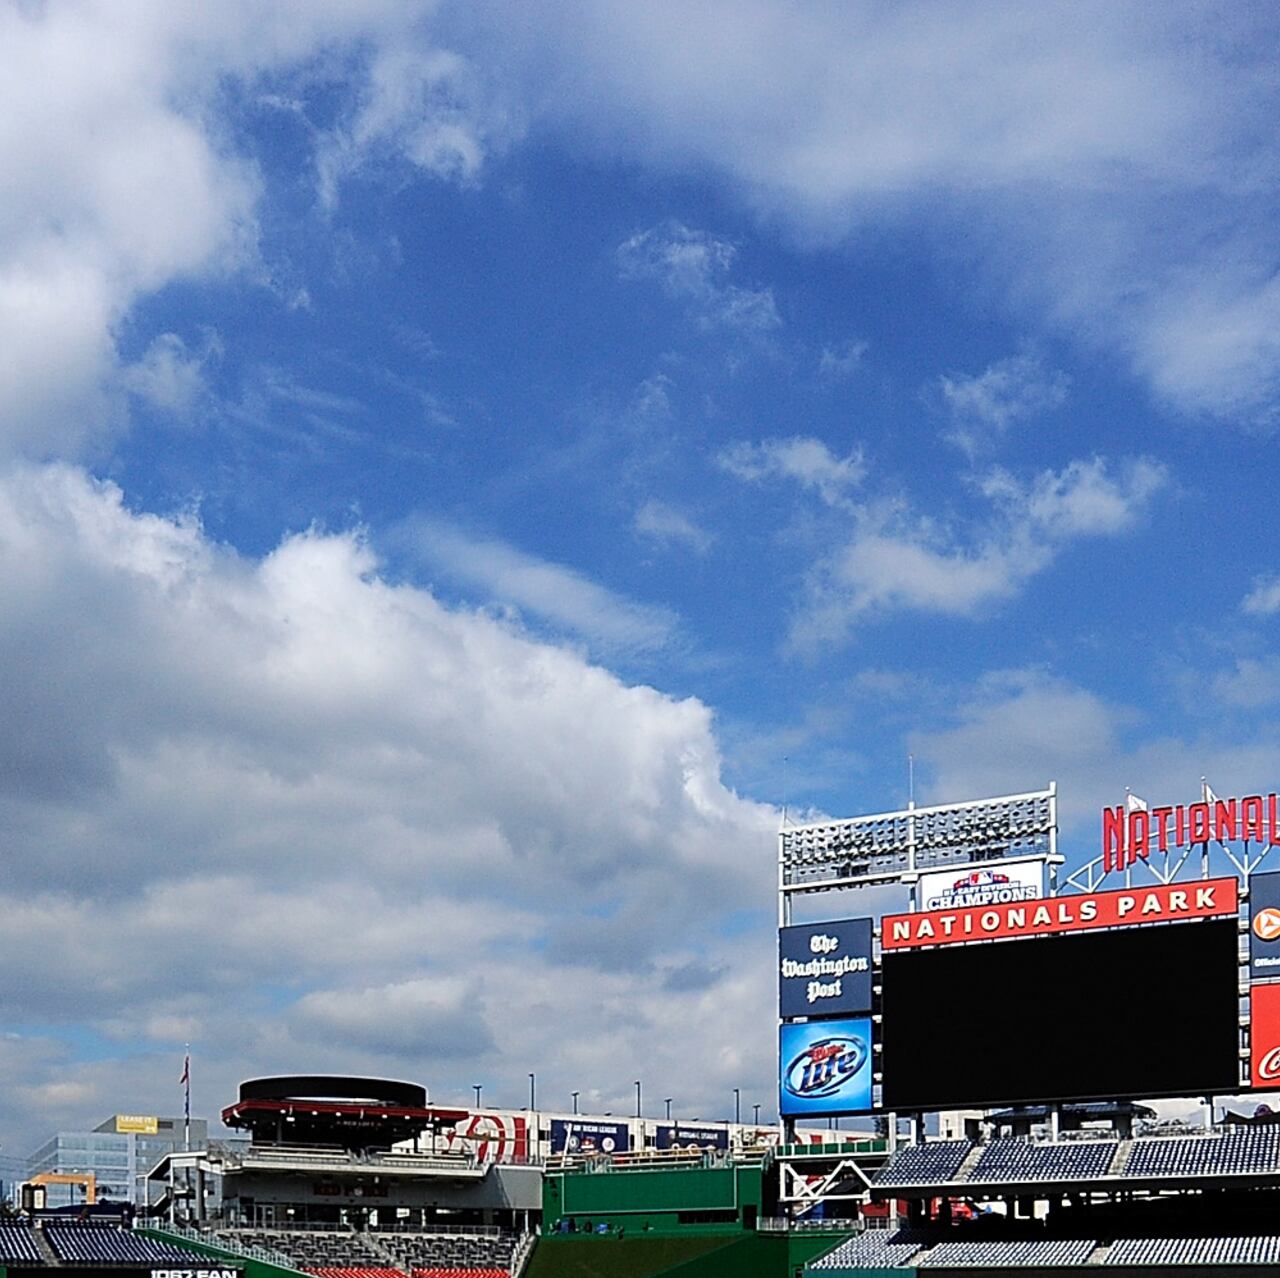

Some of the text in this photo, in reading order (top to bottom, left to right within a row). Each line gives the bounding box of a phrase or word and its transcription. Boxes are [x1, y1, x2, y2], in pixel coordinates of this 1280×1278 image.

[927, 885, 1037, 911] CHAMPIONS
[893, 886, 1217, 941] NATIONALS PARK
[810, 934, 838, 953] The
[782, 956, 869, 978] Washington
[807, 979, 842, 1003] Post
[799, 1052, 857, 1091] Lite
